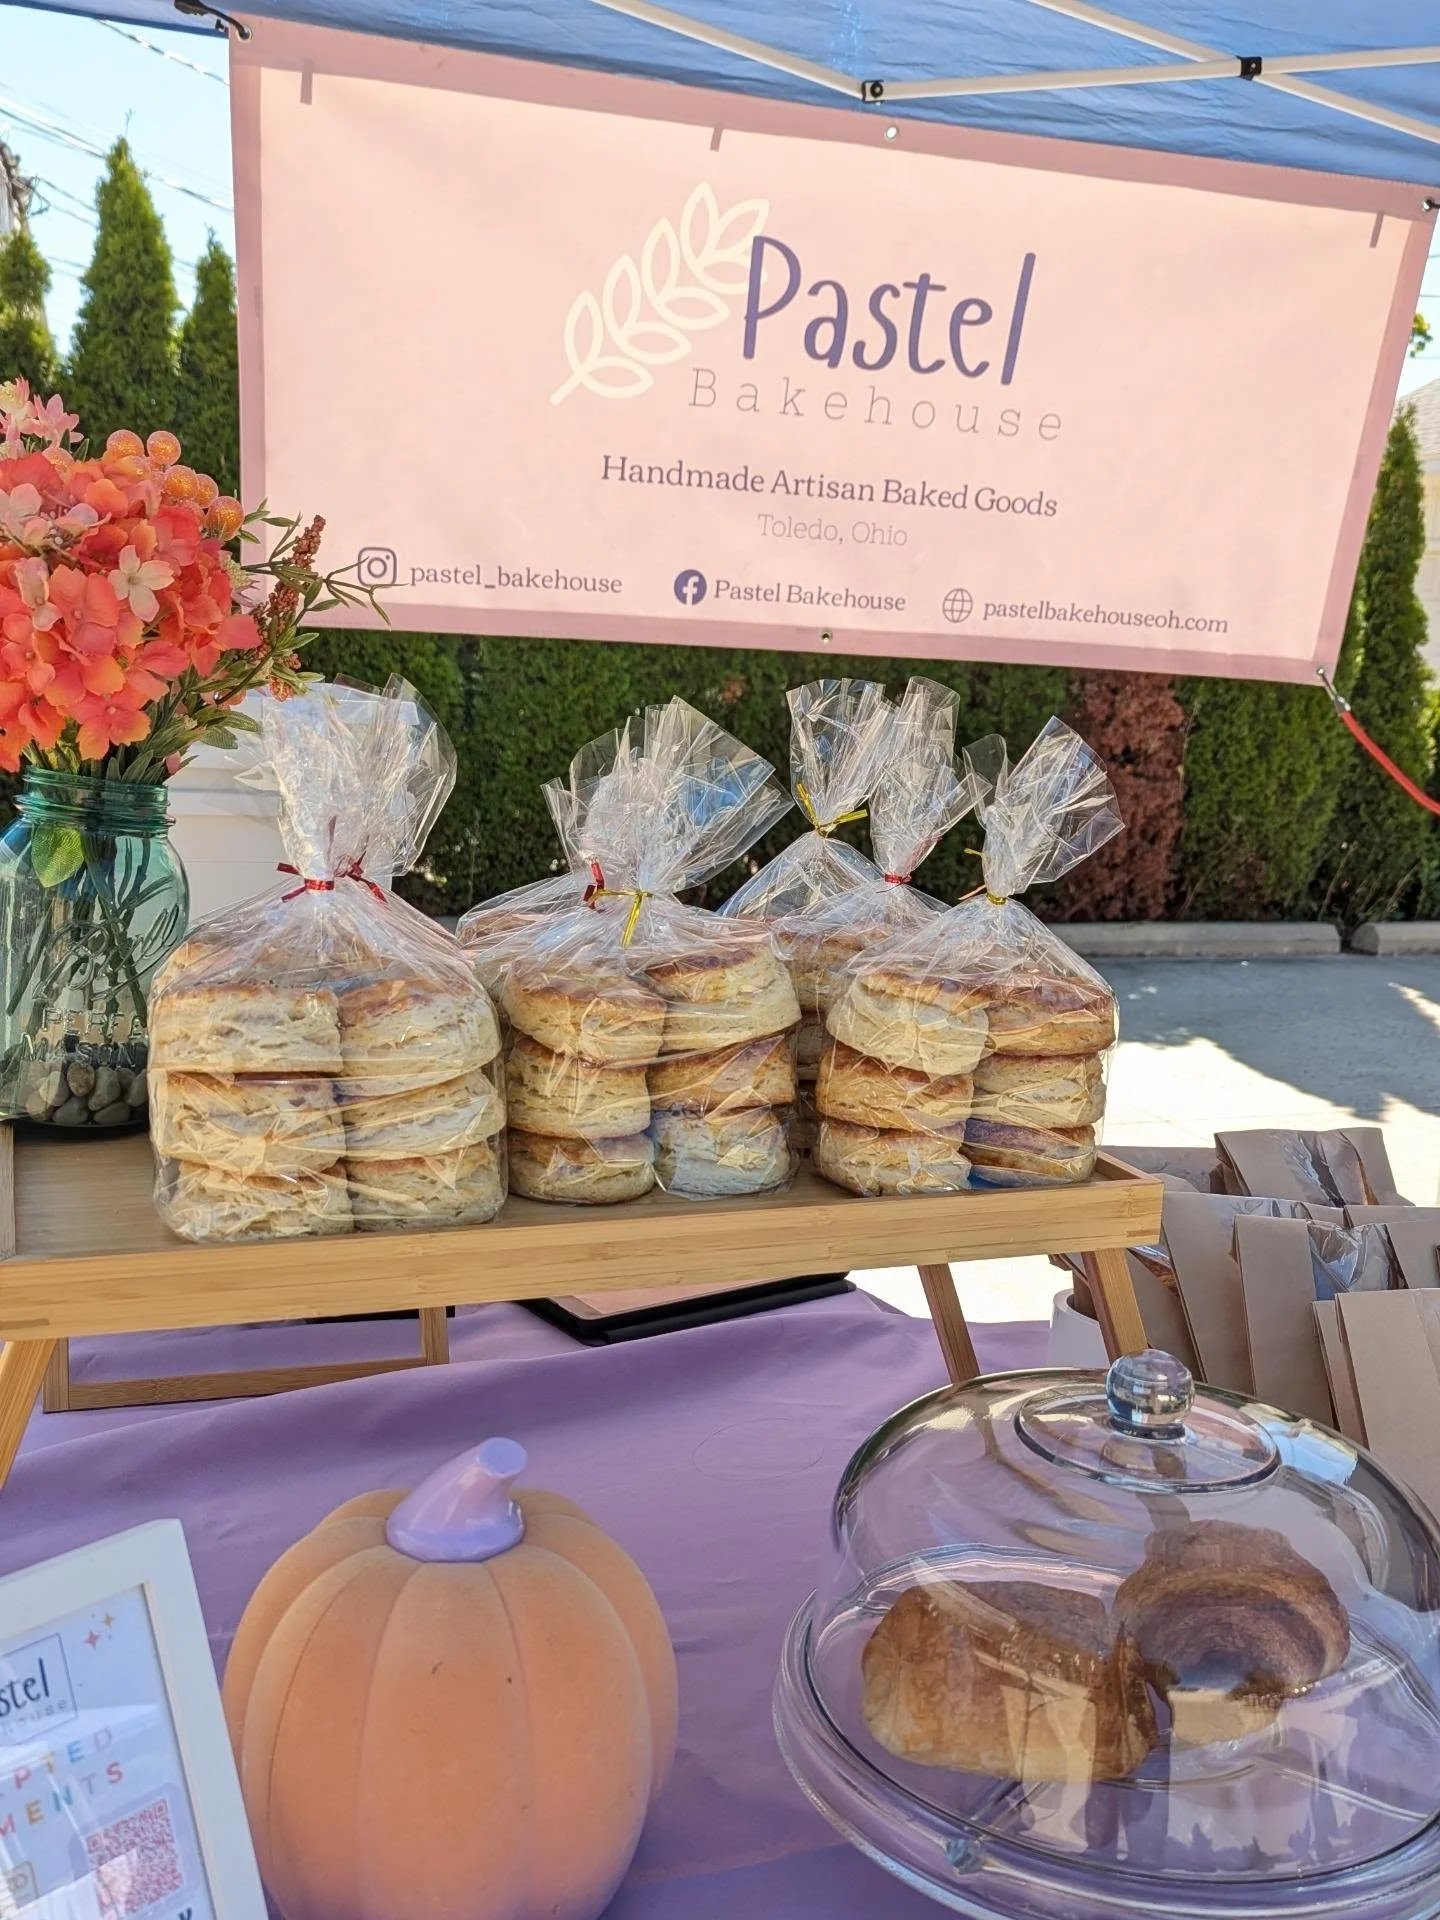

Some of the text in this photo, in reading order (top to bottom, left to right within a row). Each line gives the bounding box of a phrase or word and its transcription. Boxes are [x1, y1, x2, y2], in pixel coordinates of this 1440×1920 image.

[743, 235, 1037, 387] Pastel
[688, 367, 1063, 441] Bakehouse
[601, 454, 1059, 517] Handmade Artisan Baked Goods
[757, 513, 909, 547] Toledo, Ohio
[409, 565, 623, 594] pastel_bakehouse
[713, 579, 907, 611] Pastel Bakehouse
[982, 600, 1230, 633] pastelbakehouseoh.com
[0, 1726, 113, 1798] PTED
